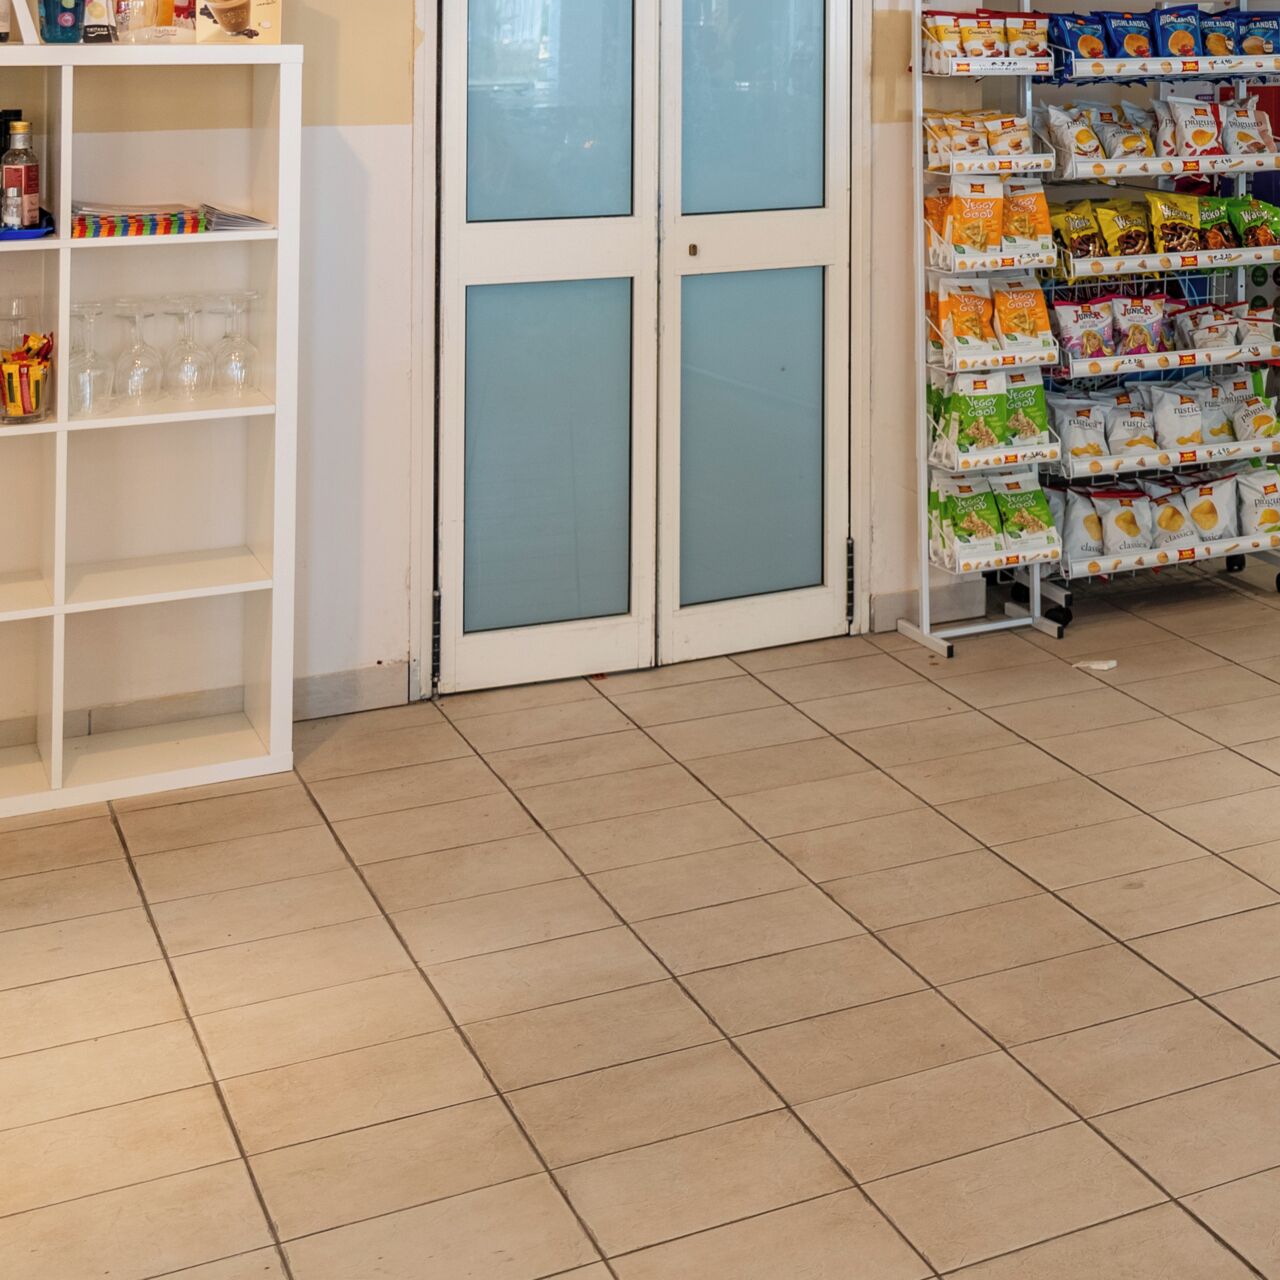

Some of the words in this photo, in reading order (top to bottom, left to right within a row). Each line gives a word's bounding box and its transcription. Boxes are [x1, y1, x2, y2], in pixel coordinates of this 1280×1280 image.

[961, 198, 996, 209] VEGGY
[963, 209, 994, 218] GOOD
[1003, 291, 1036, 302] VEGGY
[1008, 299, 1036, 308] GOOD
[1121, 303, 1152, 317] JUNIOR
[1073, 310, 1104, 324] JUNIOR
[1006, 389, 1036, 400] VEGGY
[966, 396, 997, 407] VEGGY
[1007, 398, 1035, 409] GOOD
[968, 406, 996, 417] GOOD
[953, 494, 986, 506] VEGGY
[1002, 493, 1034, 503] VEGGY
[1008, 500, 1036, 509] GOOD
[1164, 530, 1195, 544] classica
[1119, 540, 1149, 551] classica
